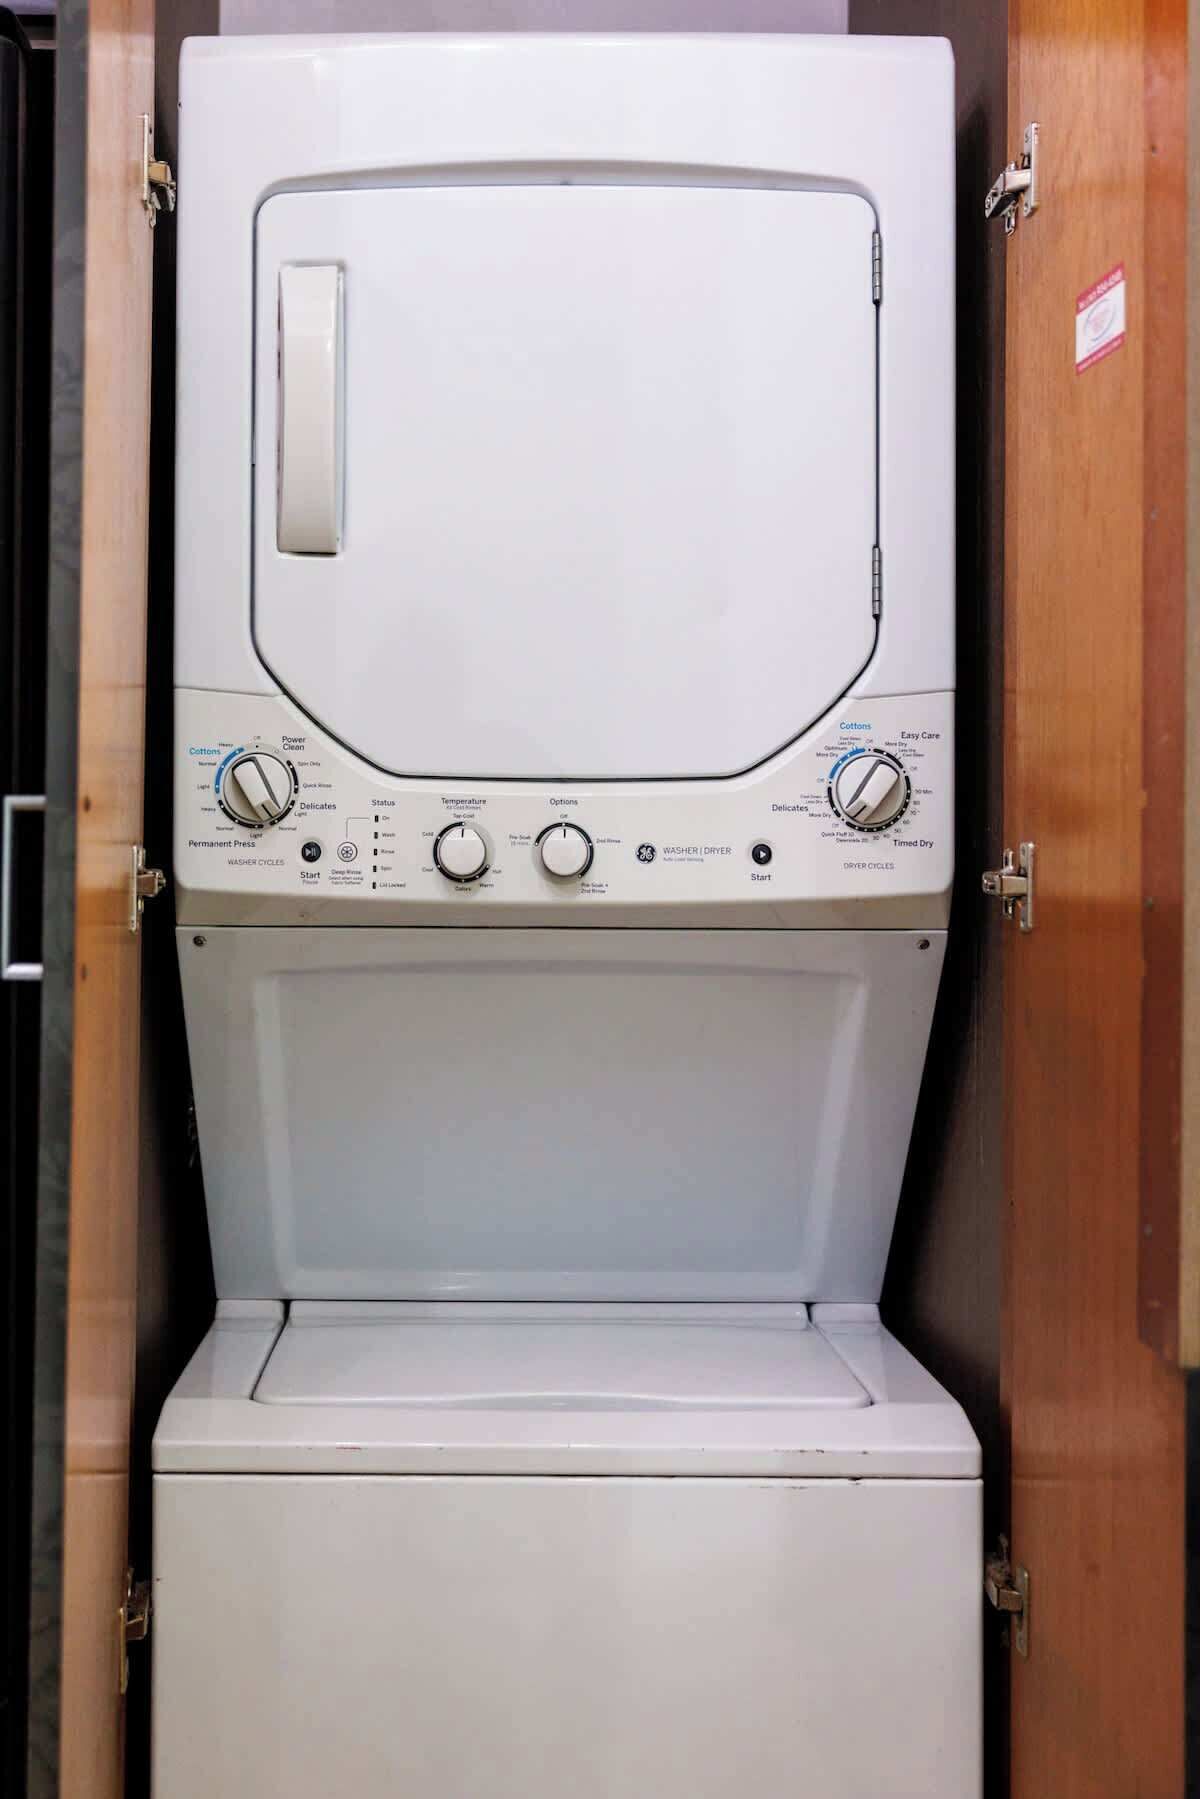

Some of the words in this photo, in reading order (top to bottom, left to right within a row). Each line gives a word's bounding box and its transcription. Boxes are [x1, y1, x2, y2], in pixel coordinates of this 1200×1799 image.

[840, 722, 872, 730] Cottons
[901, 731, 920, 740] Easy
[921, 731, 940, 739] Care
[189, 747, 221, 755] Cottons
[300, 802, 337, 810] Delicates
[441, 798, 487, 806] Temperature
[549, 798, 578, 806] Options
[188, 840, 232, 848] Permanent
[234, 840, 256, 848] Press
[920, 840, 934, 848] Dry
[663, 847, 698, 855] WASHER
[704, 847, 732, 855] DRYER
[258, 859, 285, 867] CYCLES
[843, 862, 867, 870] DRYER
[868, 862, 895, 870] CYCLES
[300, 871, 321, 879] Start
[751, 873, 771, 881] Start
